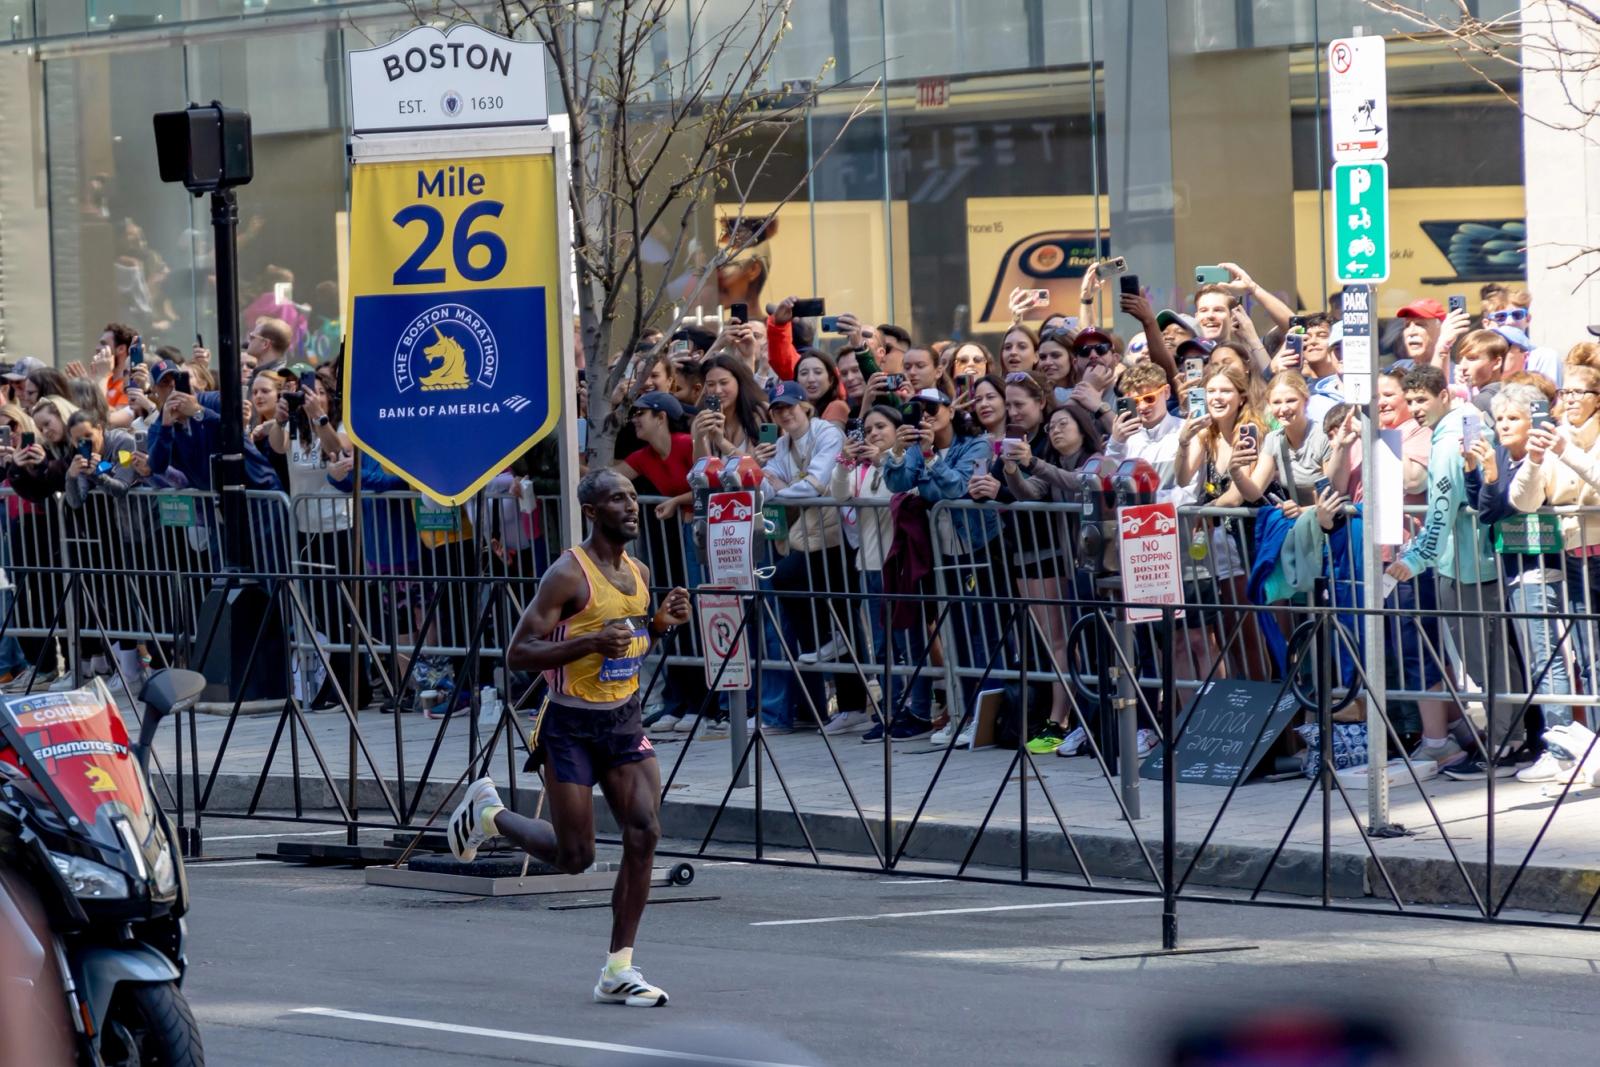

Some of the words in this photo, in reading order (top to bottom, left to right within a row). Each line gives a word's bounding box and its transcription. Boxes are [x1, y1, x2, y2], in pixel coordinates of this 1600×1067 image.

[382, 42, 512, 82] BOSTON
[398, 99, 426, 114] EST.
[470, 95, 504, 110] 1630
[417, 165, 486, 198] Mile
[1349, 168, 1371, 205] P
[391, 200, 508, 286] 26
[1343, 292, 1369, 311] PARK
[1343, 312, 1369, 325] BOSTON
[402, 307, 450, 347] BOSTON
[455, 308, 495, 378] MARATHON
[397, 352, 408, 384] THE
[379, 406, 416, 418] BANK
[418, 405, 436, 416] OF
[438, 402, 500, 416] AMERICA
[722, 525, 736, 536] NO
[713, 537, 746, 547] STOPPING
[1142, 540, 1160, 552] NO
[716, 548, 743, 556] BOSTON
[718, 556, 742, 564] POLICE
[1130, 552, 1173, 564] STOPPING
[1133, 563, 1171, 574] BOSTON
[1135, 572, 1170, 582] POLICE
